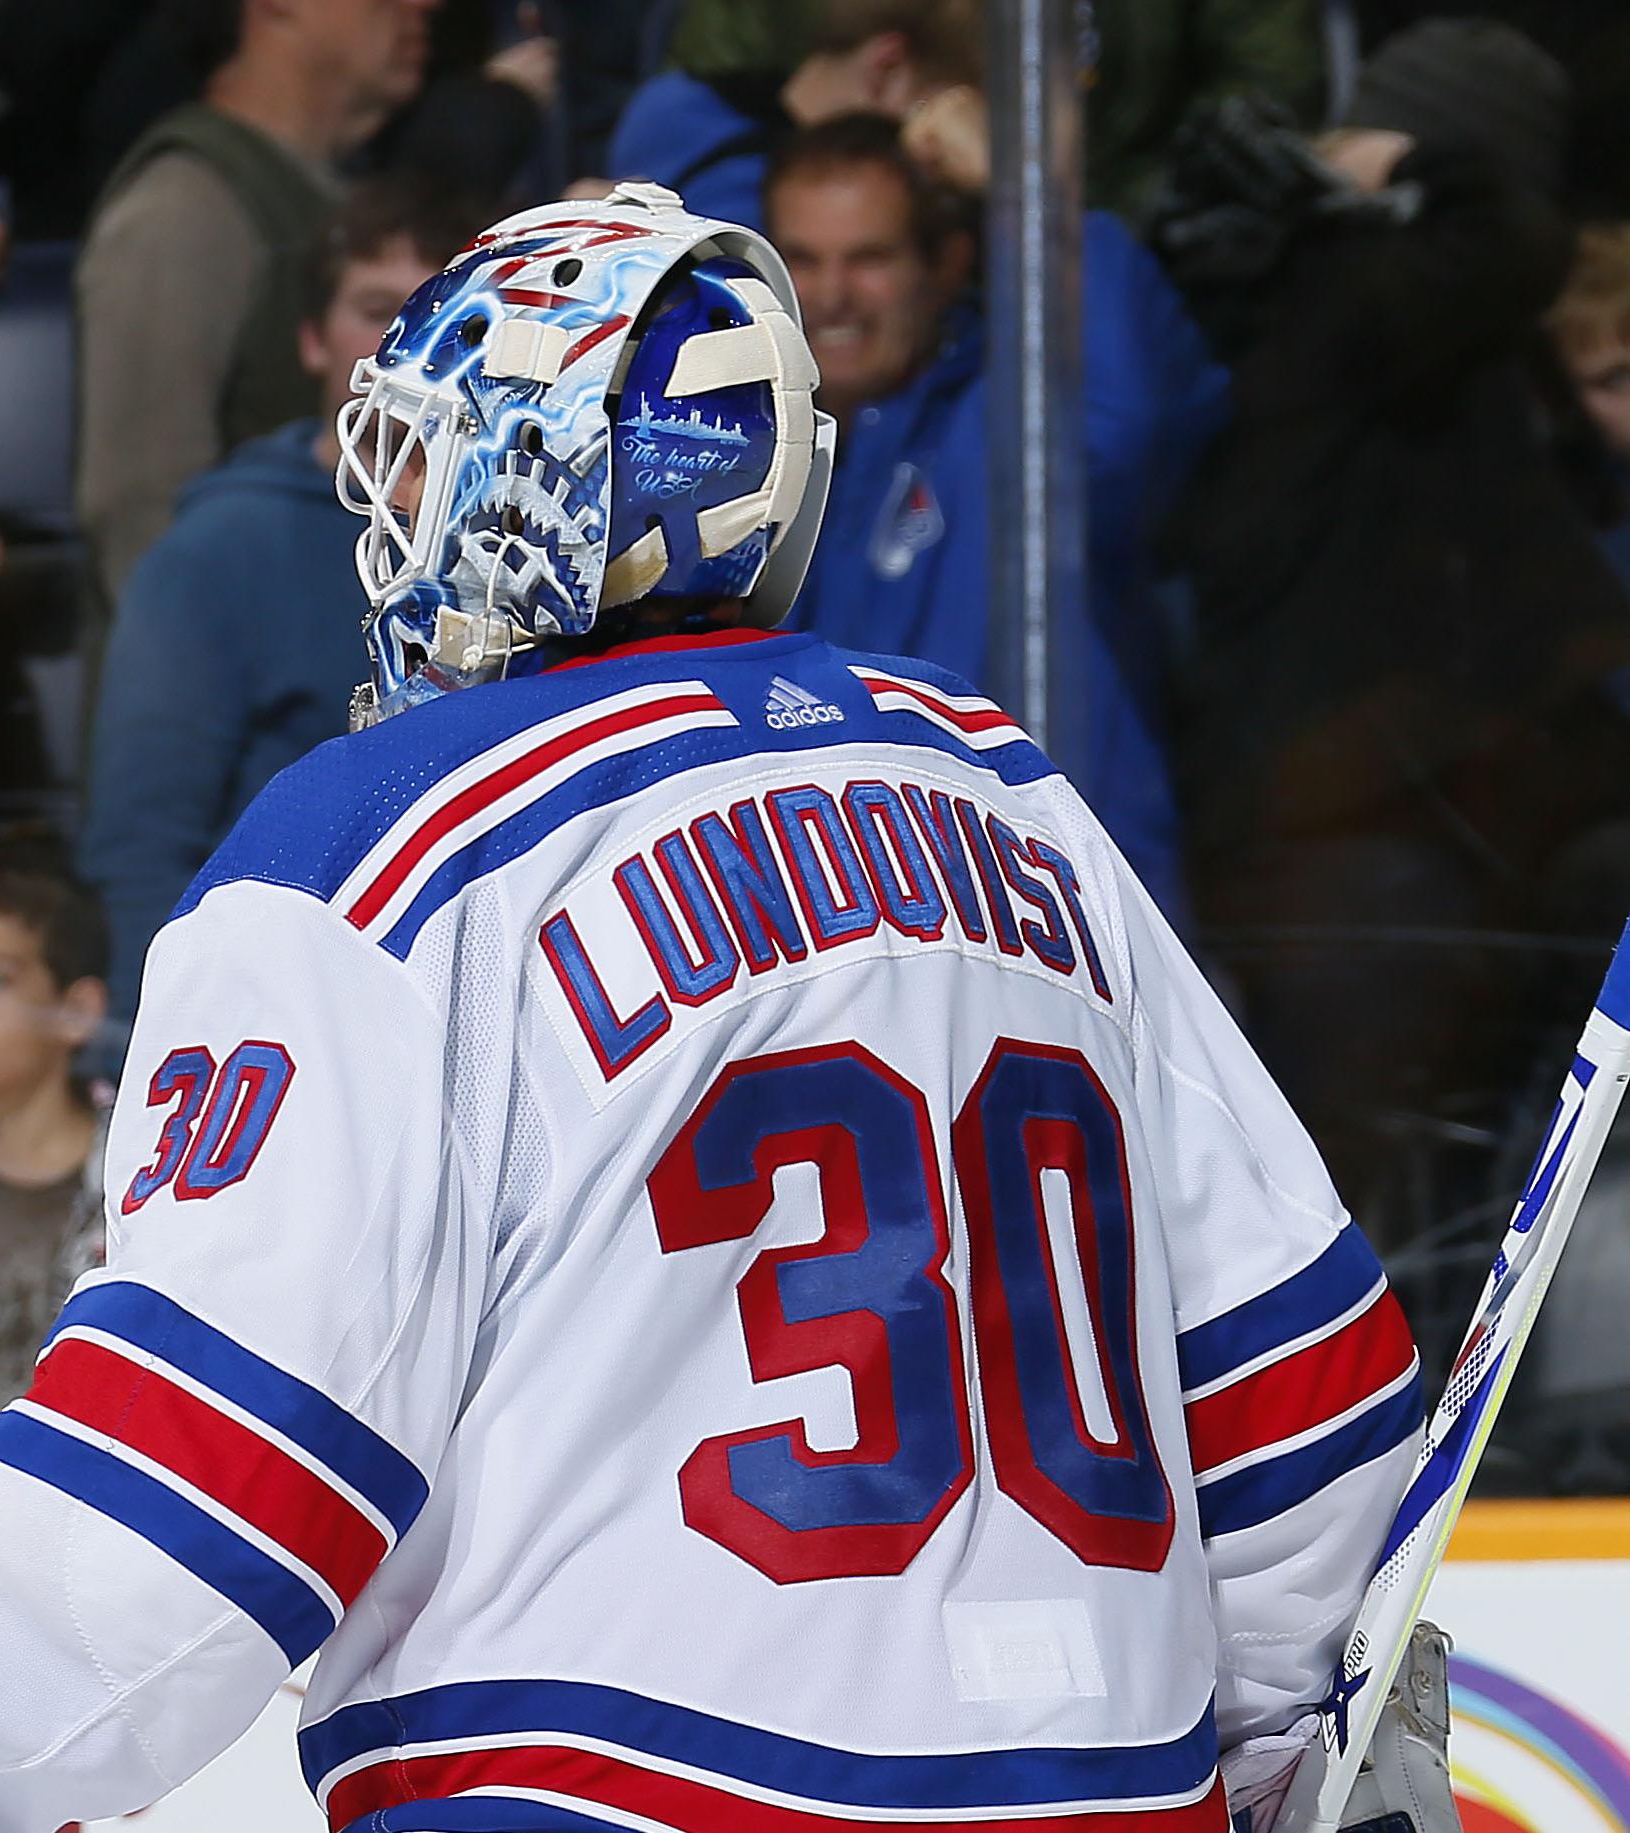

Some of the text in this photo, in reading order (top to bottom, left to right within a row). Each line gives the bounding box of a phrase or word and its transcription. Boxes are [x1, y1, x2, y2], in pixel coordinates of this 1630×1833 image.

[622, 436, 660, 463] The
[664, 448, 722, 471] heart
[766, 704, 845, 730] adidas
[540, 780, 1113, 1083] LUNDQVIST
[121, 1040, 296, 1216] 30
[646, 1036, 1175, 1586] 30
[1343, 1629, 1370, 1678] PRO
